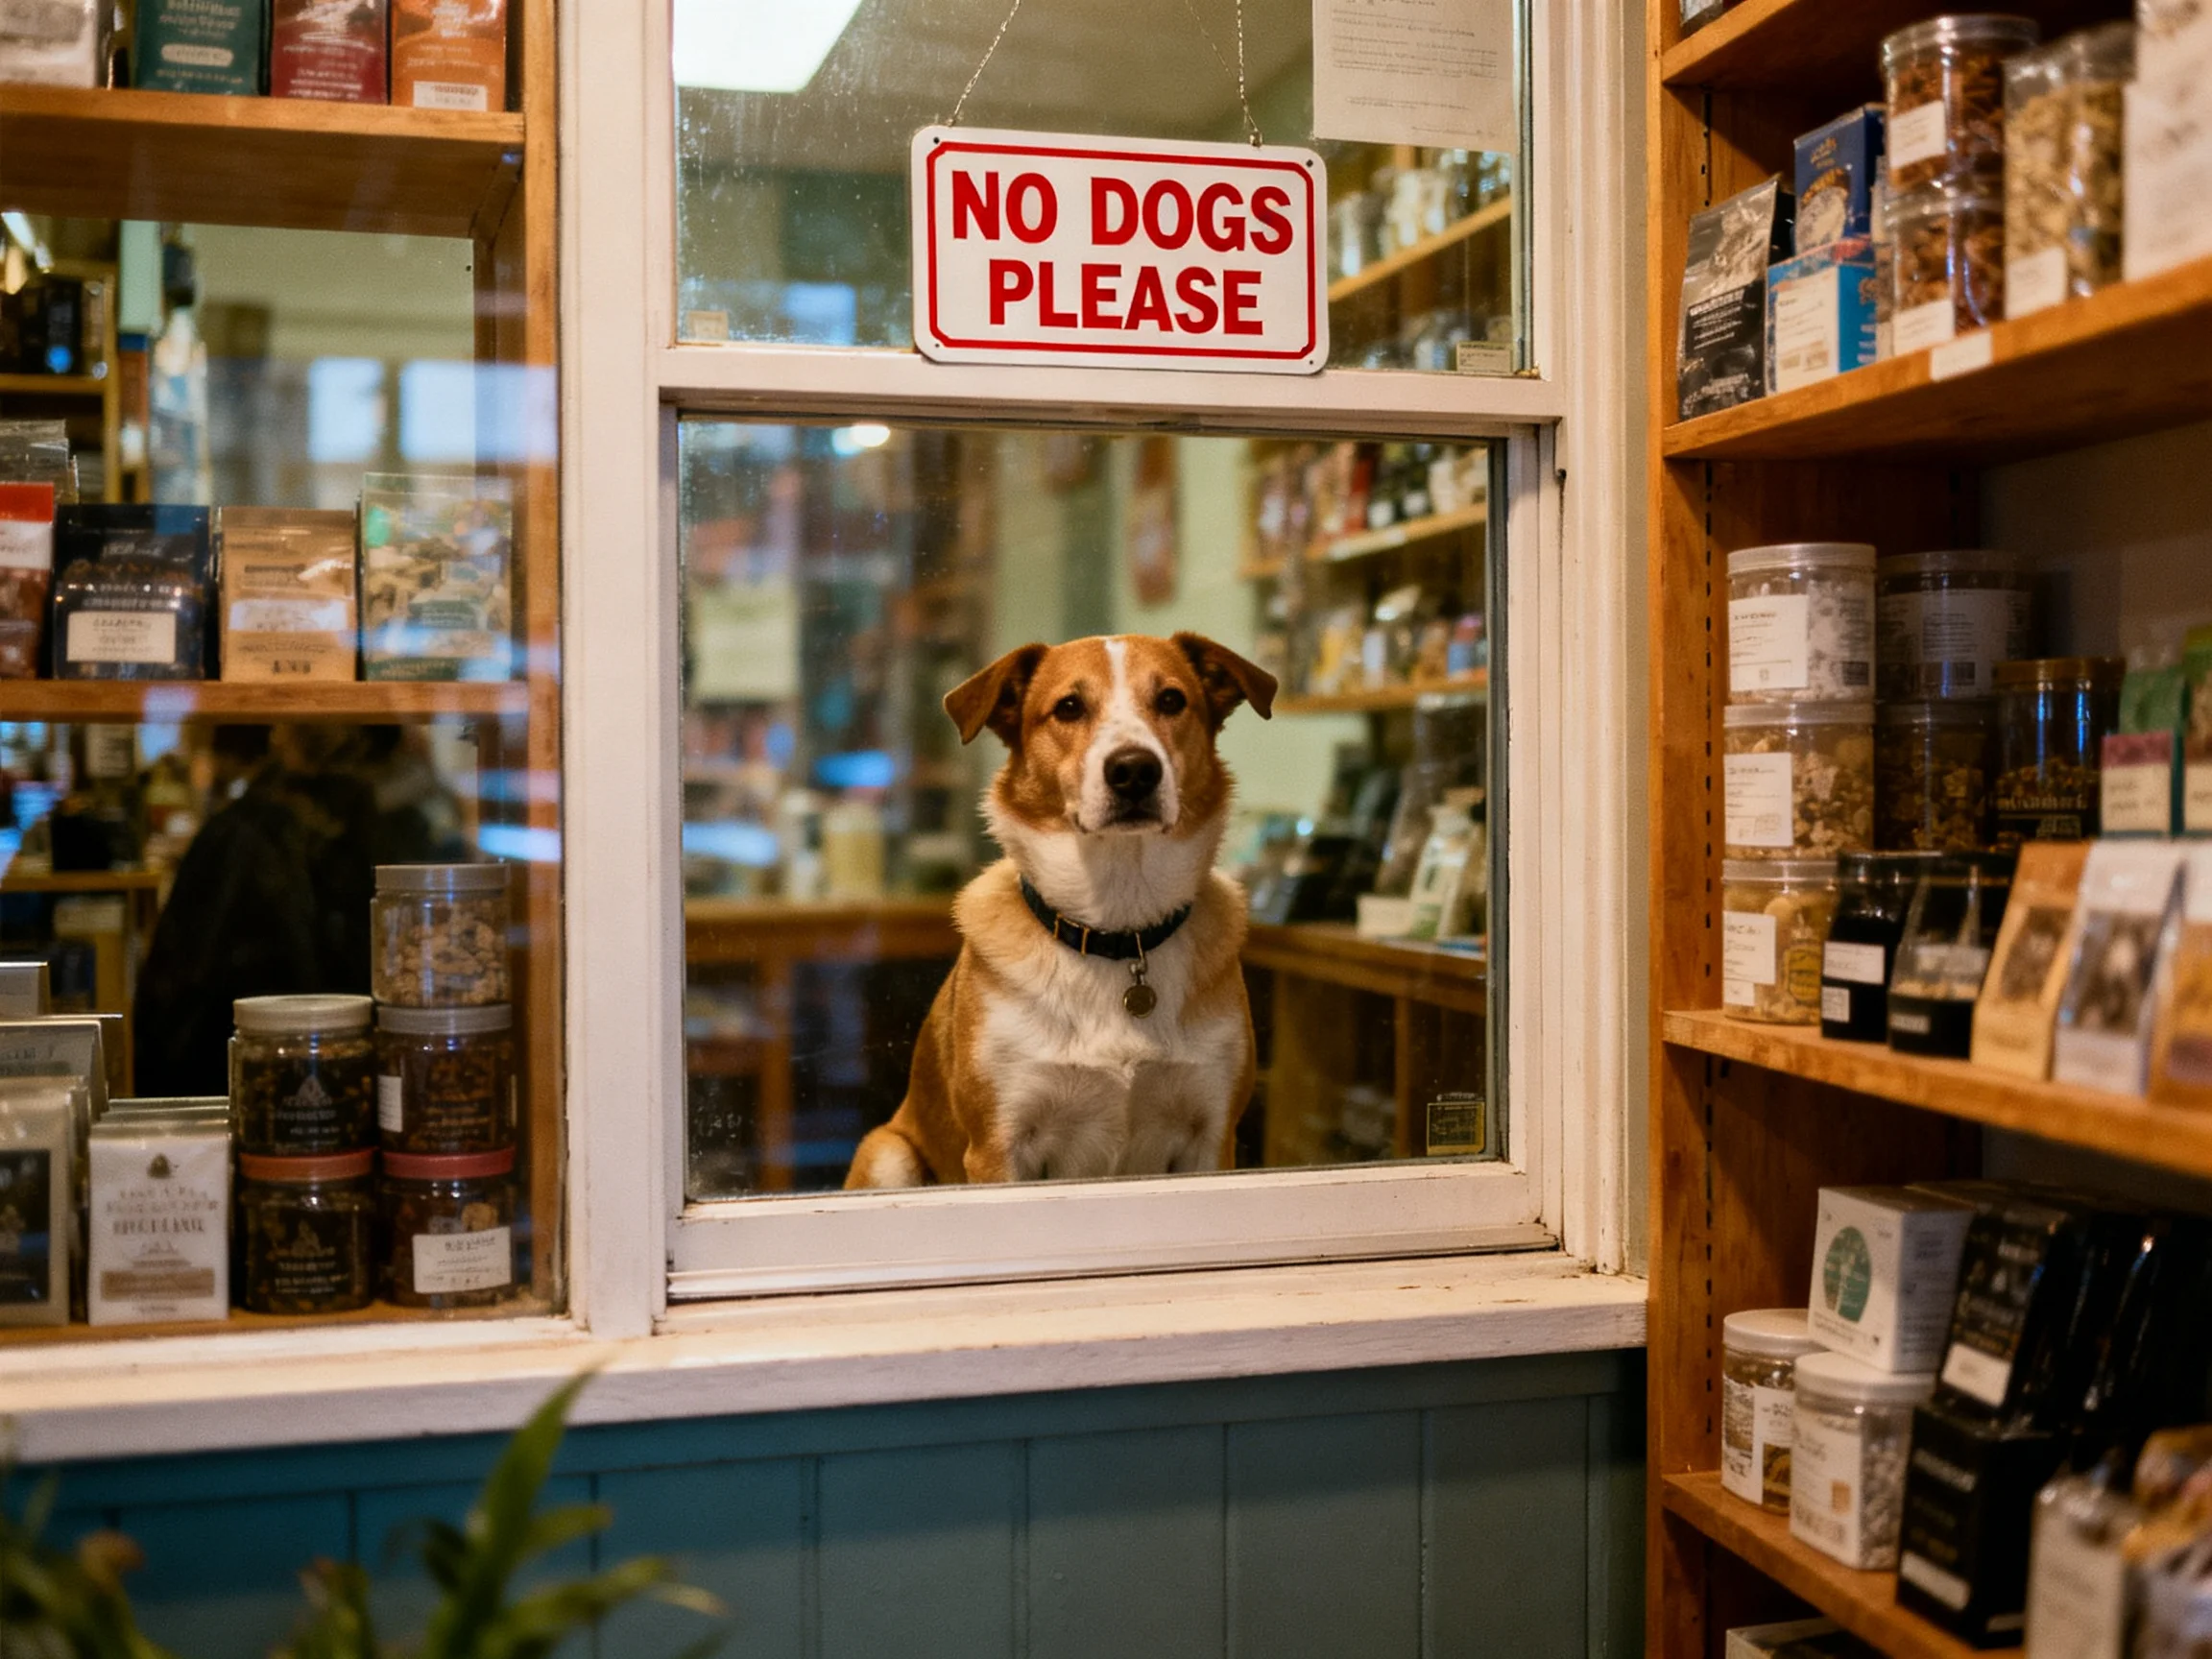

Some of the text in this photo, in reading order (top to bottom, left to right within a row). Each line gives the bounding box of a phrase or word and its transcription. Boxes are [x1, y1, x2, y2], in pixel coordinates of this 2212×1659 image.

[951, 170, 1294, 256] NO DOGS
[989, 259, 1264, 337] PLEASE
